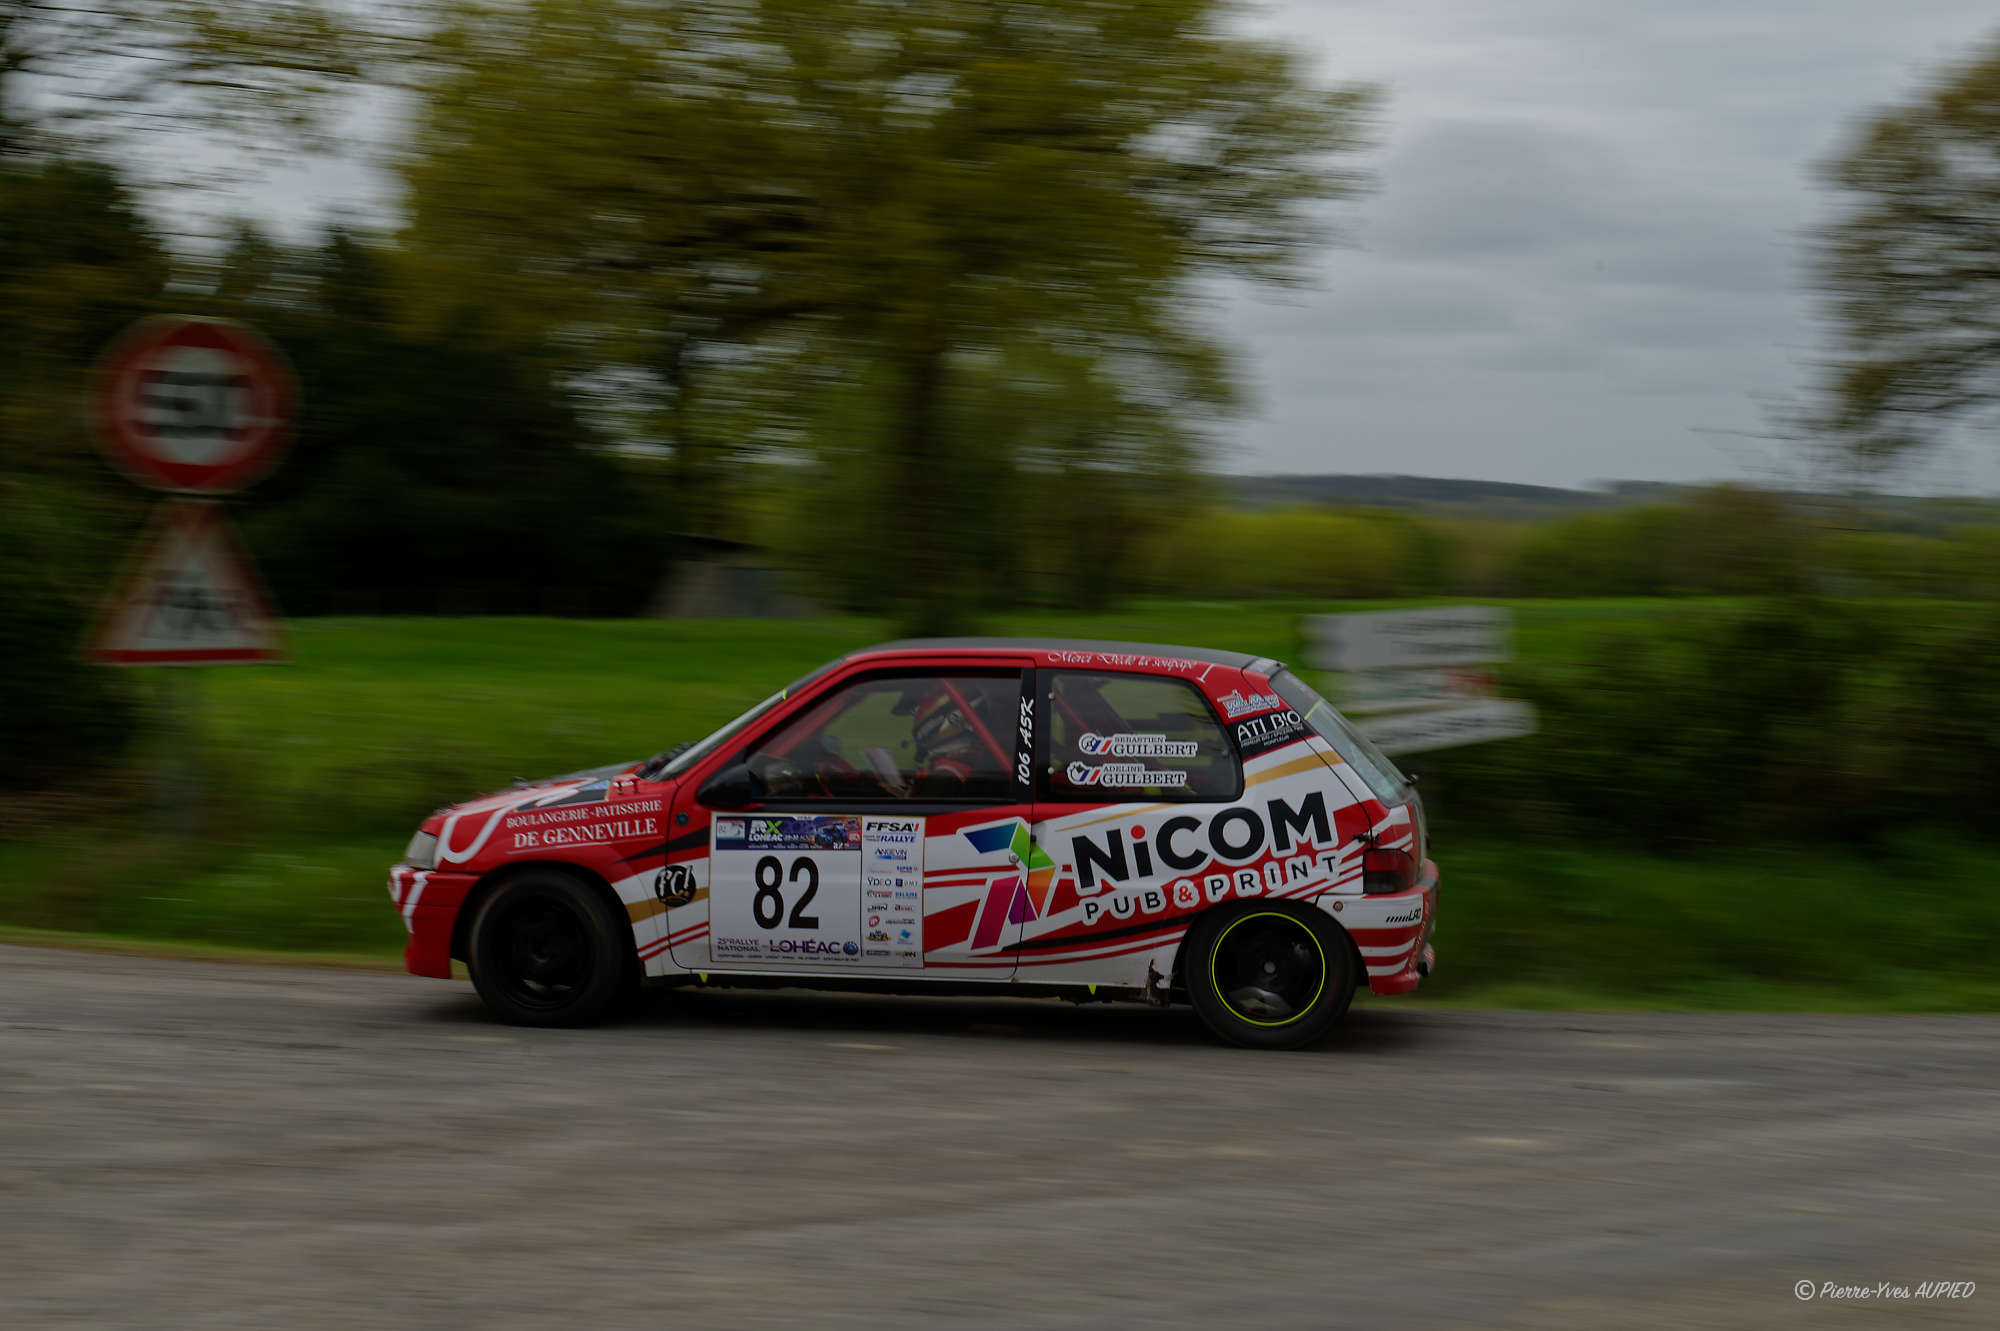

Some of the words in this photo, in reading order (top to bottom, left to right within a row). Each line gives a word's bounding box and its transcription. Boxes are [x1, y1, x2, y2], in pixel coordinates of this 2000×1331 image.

[1270, 710, 1301, 731] BIO
[1113, 743, 1197, 755] GUILBERT
[1018, 751, 1031, 786] 106
[1103, 765, 1143, 773] ADELINE
[1103, 773, 1185, 785] GUILBERT
[513, 831, 541, 848] DE
[542, 818, 659, 845] GENNEVILLE
[866, 822, 913, 832] FFSA
[753, 855, 819, 929] 82
[769, 938, 841, 954] LOHÉAC
